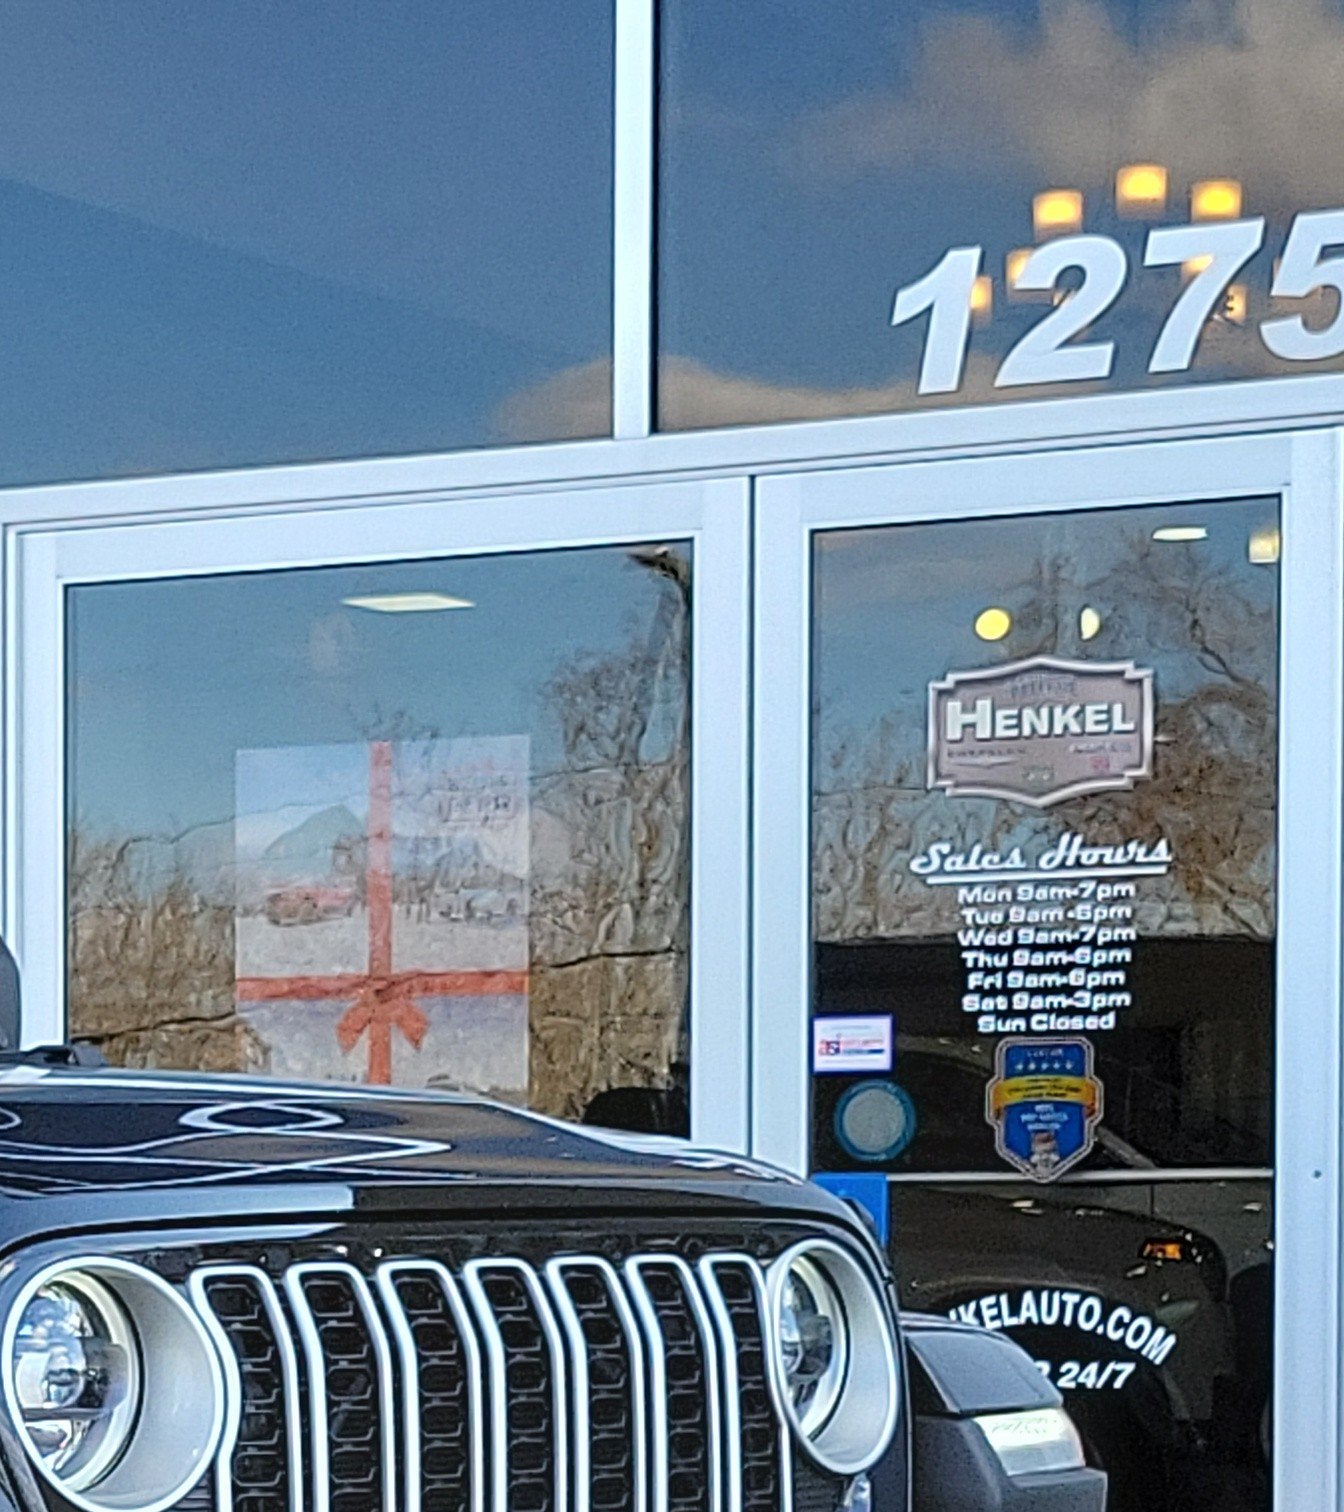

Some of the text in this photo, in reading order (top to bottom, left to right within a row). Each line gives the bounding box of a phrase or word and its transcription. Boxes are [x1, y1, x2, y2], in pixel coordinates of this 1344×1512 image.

[891, 207, 1344, 396] 1275
[945, 697, 1137, 742] HENKEL
[910, 832, 1172, 874] Sales Hours
[958, 884, 1011, 904] Mon
[962, 907, 1005, 925] Tue
[957, 928, 1013, 947] Wed
[960, 949, 1009, 968] Thu
[967, 971, 1003, 990] Fri
[961, 993, 1009, 1012] Sat
[977, 1011, 1117, 1033] Sun Closed
[948, 1290, 1177, 1365] KELAUTO.COM
[1057, 1361, 1137, 1389] 24/7
